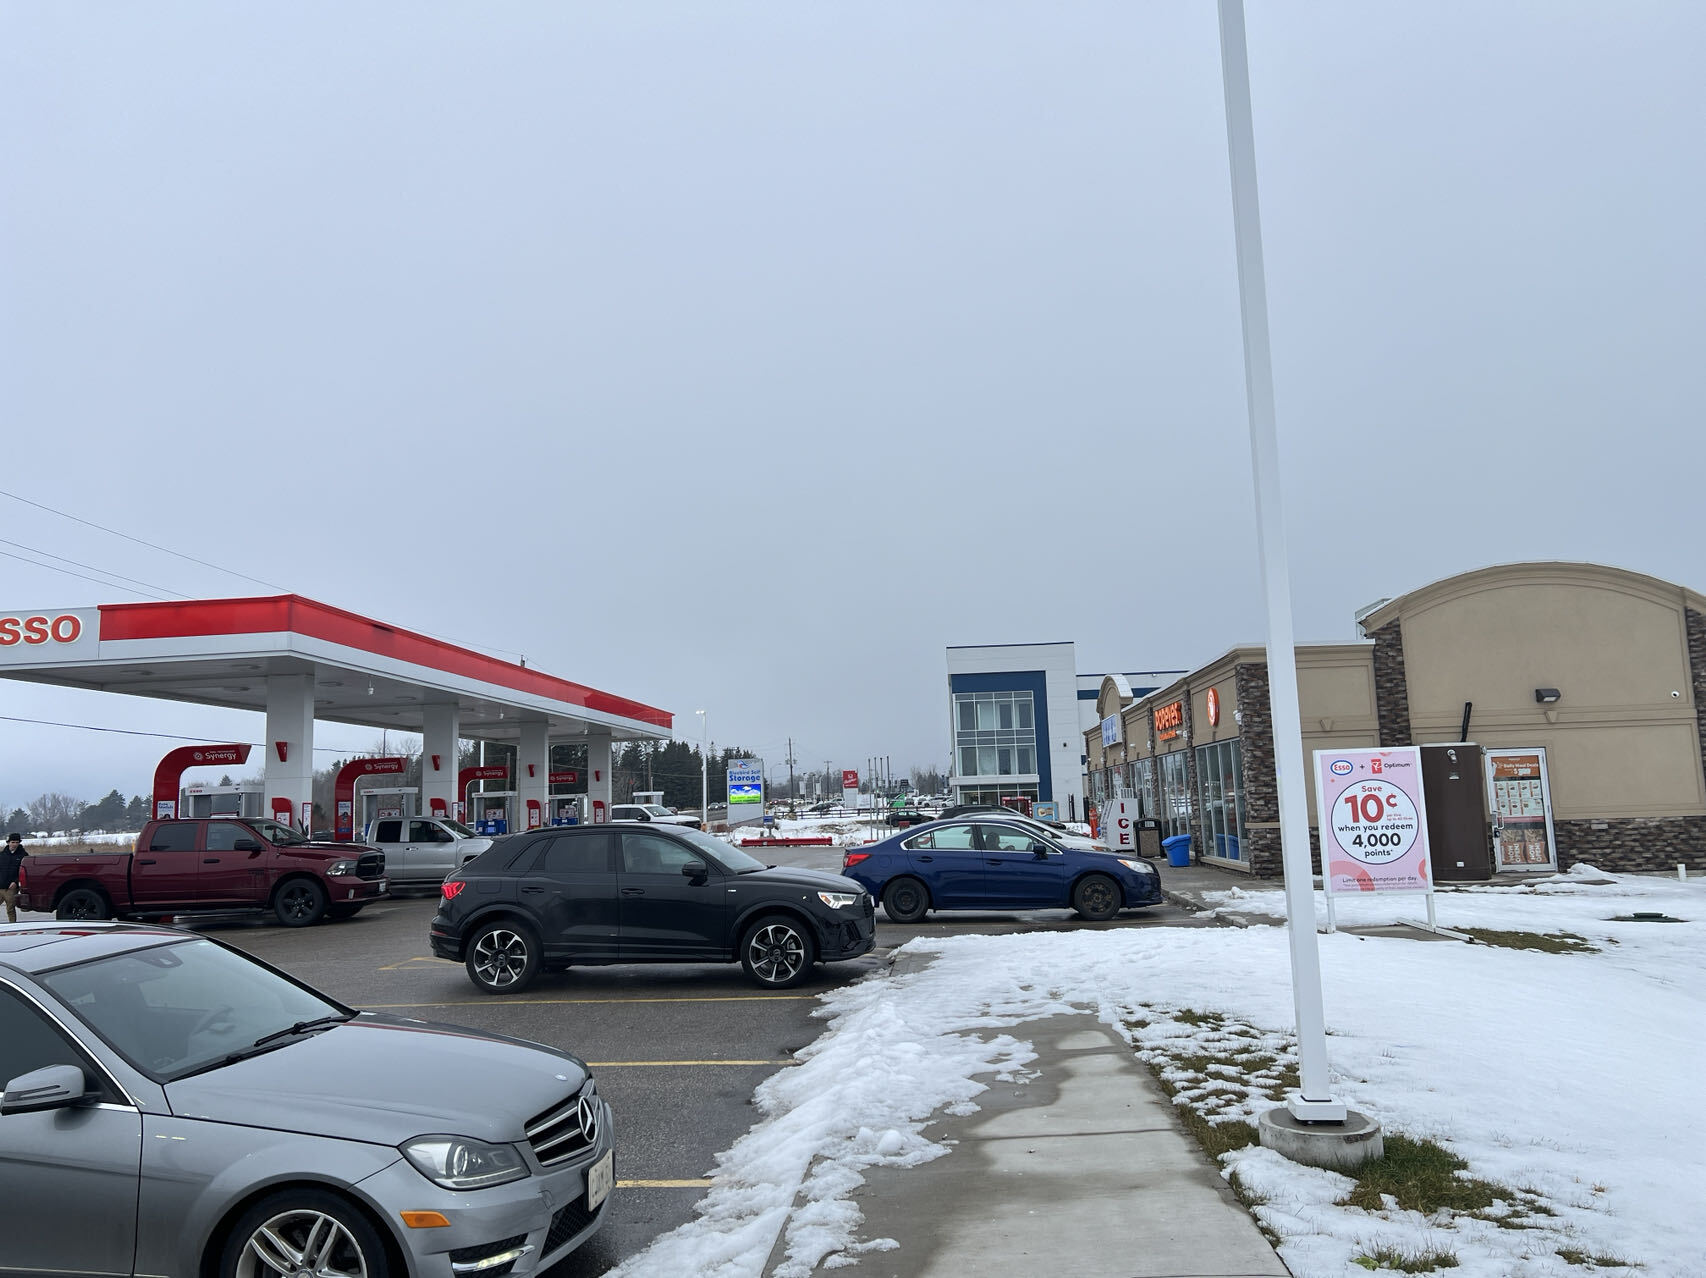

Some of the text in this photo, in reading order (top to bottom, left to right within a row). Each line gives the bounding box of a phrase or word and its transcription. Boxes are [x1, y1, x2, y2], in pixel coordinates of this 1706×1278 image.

[205, 752, 236, 760] Synergy
[1361, 785, 1382, 793] Save
[1118, 803, 1130, 845] ICE
[1364, 825, 1378, 833] you
[1352, 833, 1401, 848] 4,000
